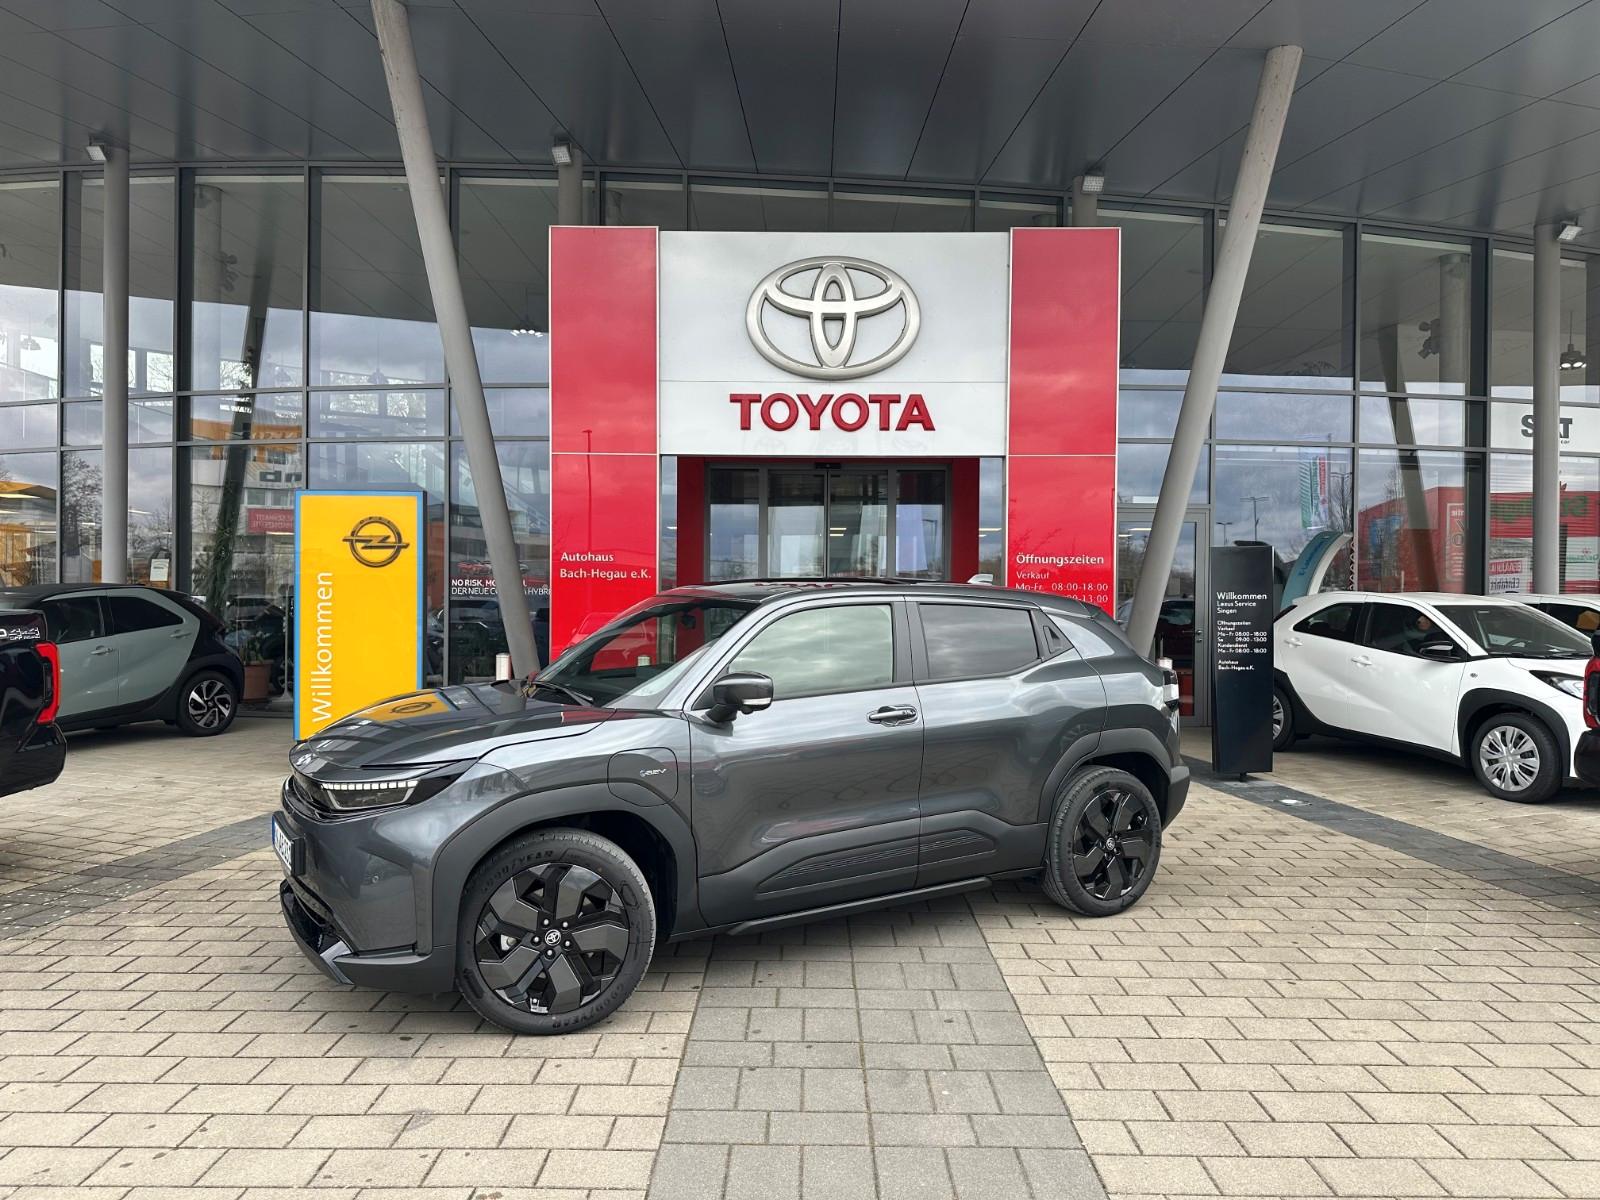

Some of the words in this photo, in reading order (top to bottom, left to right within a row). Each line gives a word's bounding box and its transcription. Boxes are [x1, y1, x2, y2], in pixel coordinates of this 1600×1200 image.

[729, 392, 936, 432] TOYOTA
[560, 552, 615, 562] Autohaus
[1016, 552, 1104, 567] Öffnungszeiten
[559, 568, 627, 581] Bach-Hegau
[630, 568, 652, 579] e.K.
[1016, 571, 1050, 580] Verkauf
[451, 579, 464, 587] NO
[464, 579, 485, 588] RISK,
[451, 587, 467, 595] DER
[468, 587, 490, 595] NEUE
[1216, 591, 1268, 600] Willkommen
[1216, 607, 1237, 615] Singen
[311, 571, 333, 723] Willkommen
